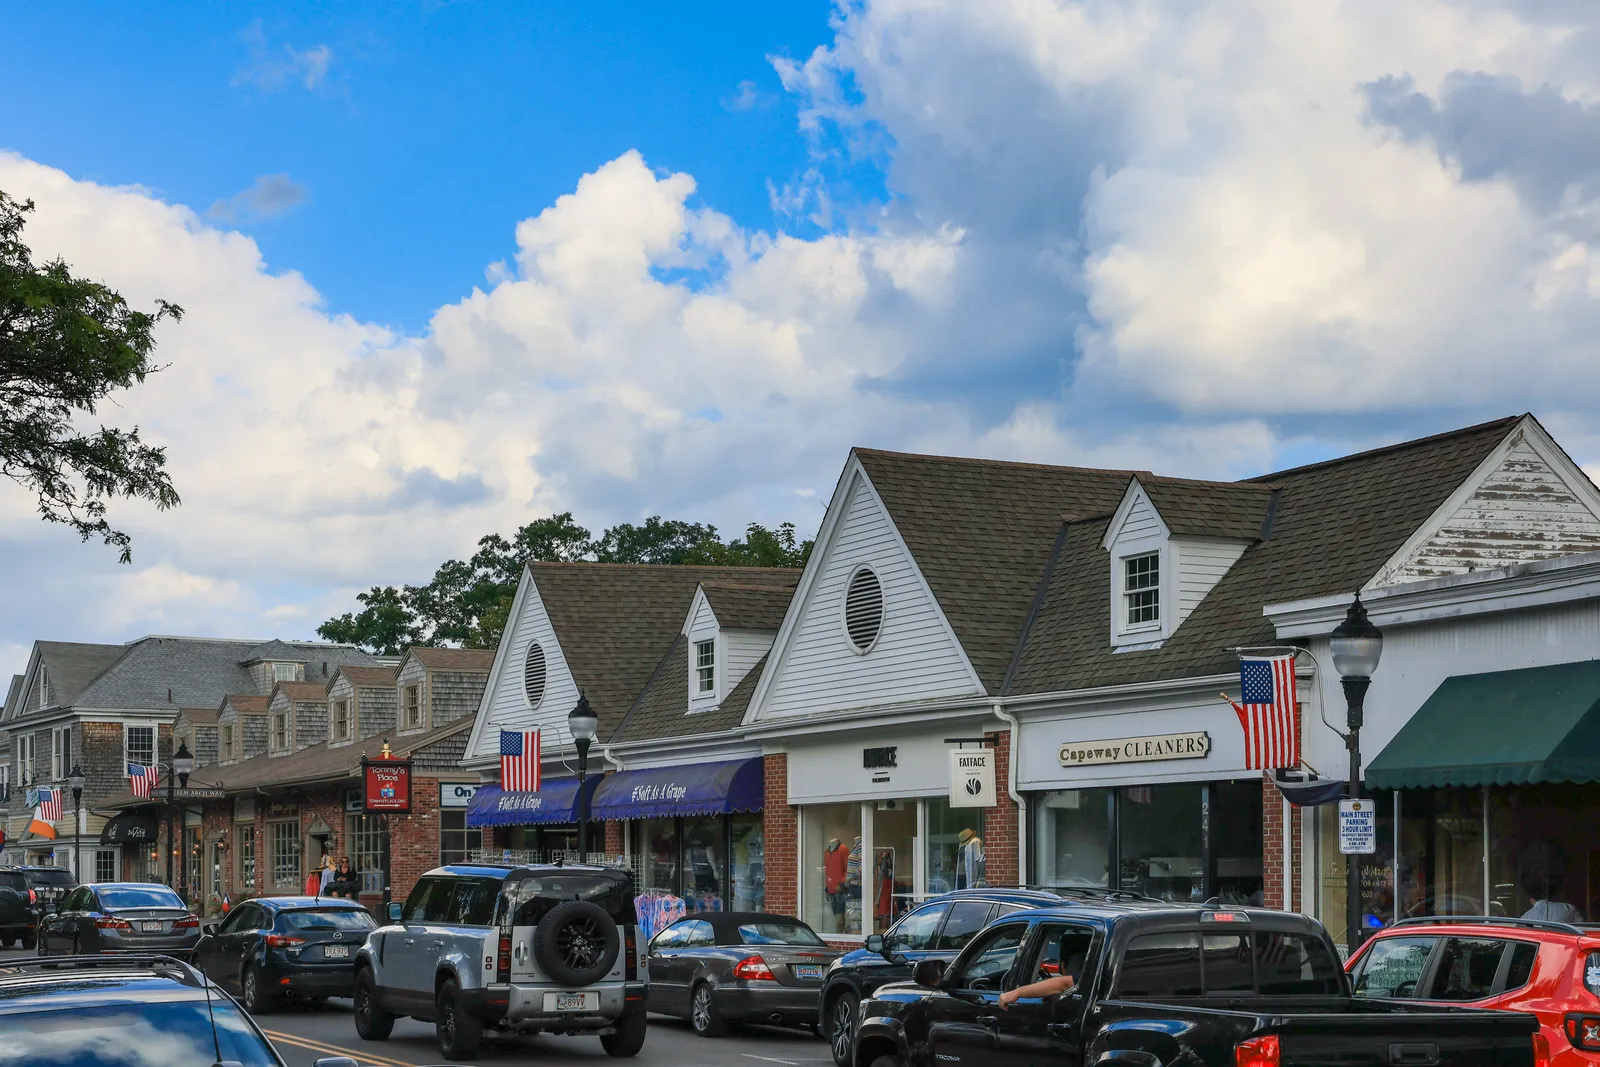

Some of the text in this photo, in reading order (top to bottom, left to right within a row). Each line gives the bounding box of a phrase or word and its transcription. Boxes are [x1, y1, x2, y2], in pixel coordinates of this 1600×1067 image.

[1060, 736, 1205, 762] Capeway CLEANERS
[959, 757, 986, 767] FATFACE
[370, 766, 405, 775] Tommy's
[454, 786, 472, 797] On
[650, 784, 660, 800] As
[660, 784, 667, 799] A
[666, 783, 686, 802] Grape
[525, 794, 541, 811] Grape
